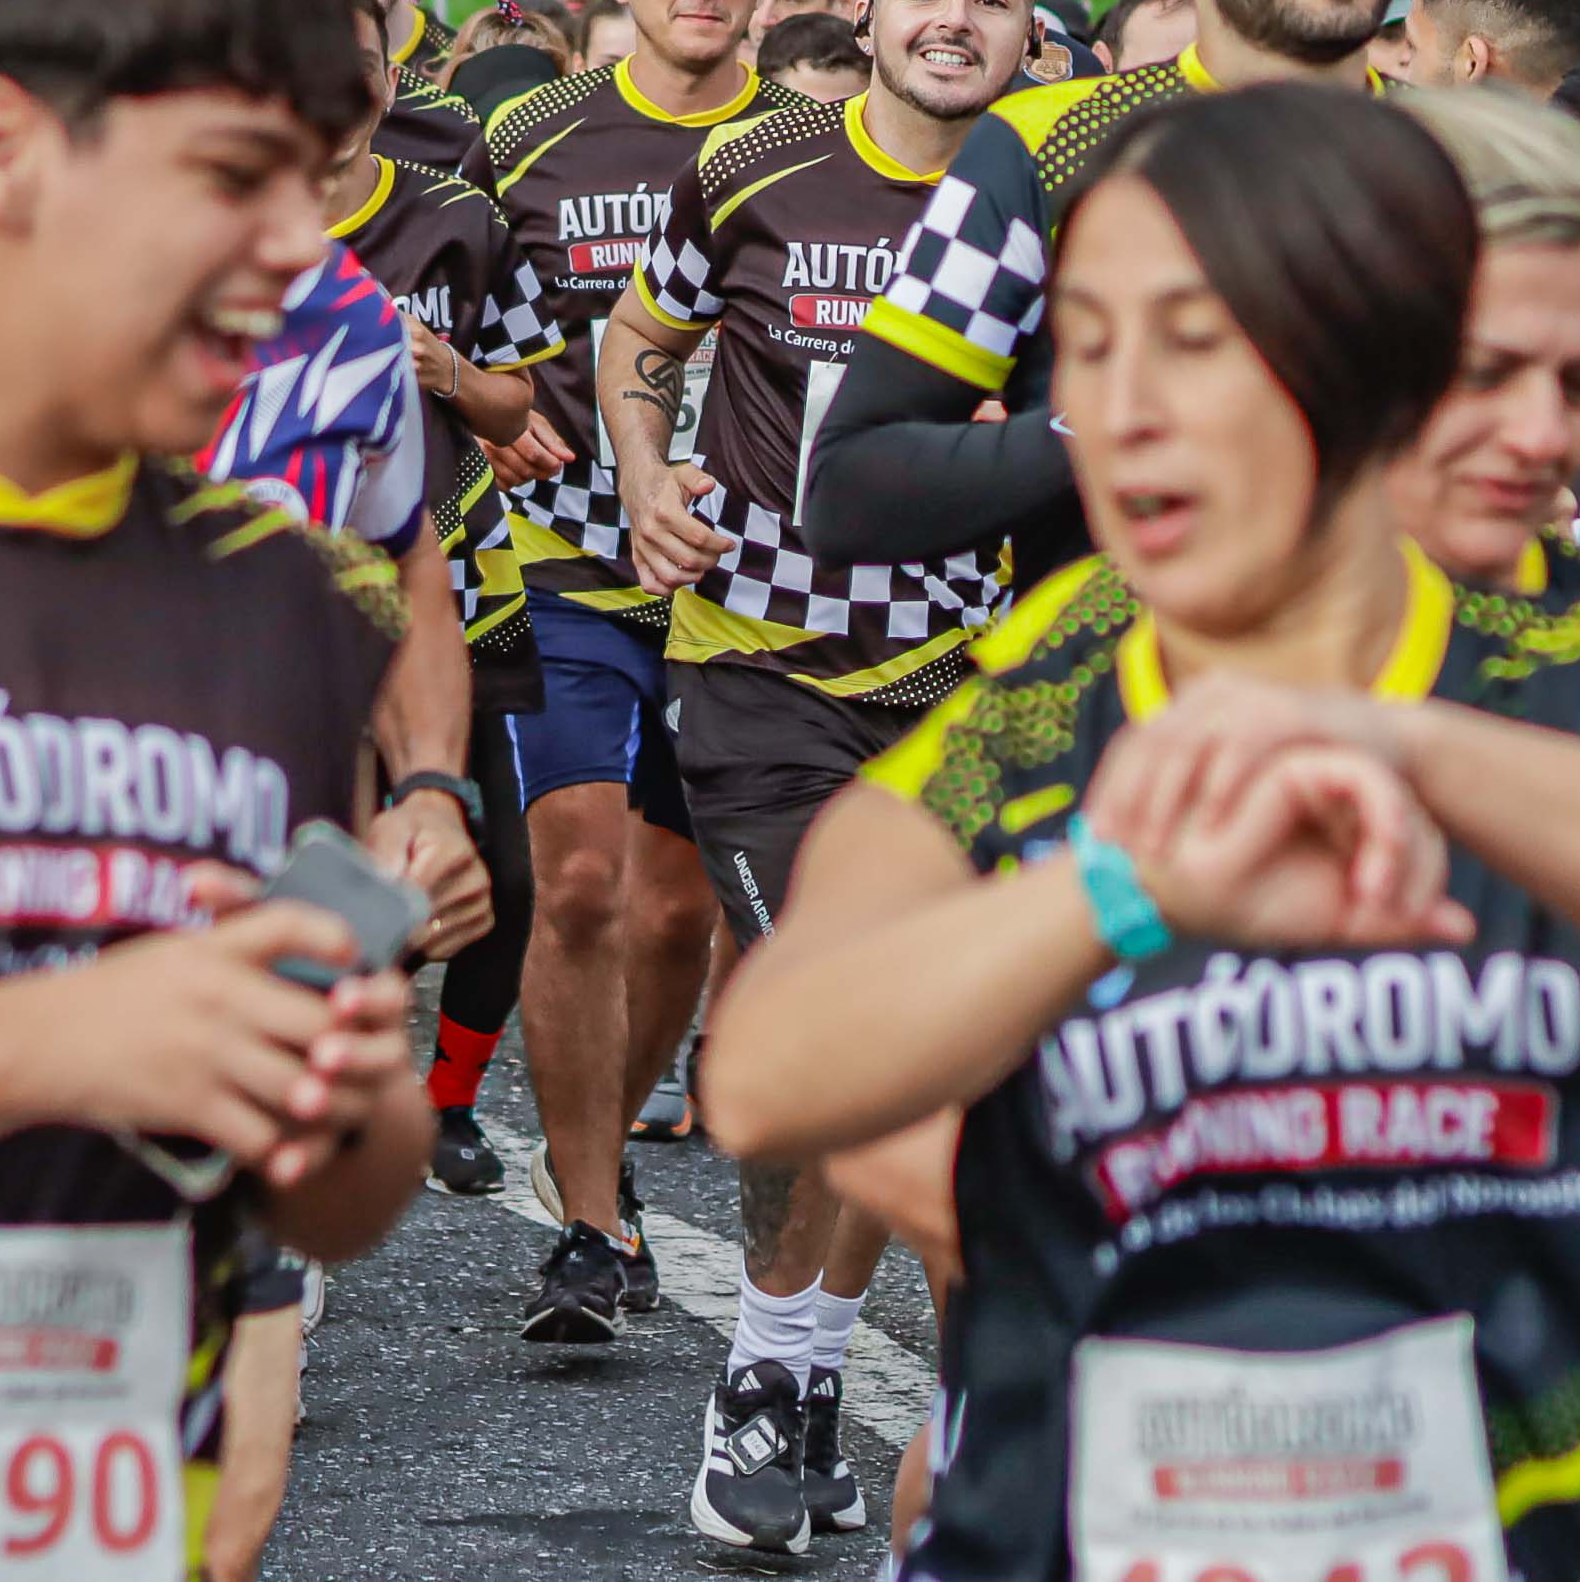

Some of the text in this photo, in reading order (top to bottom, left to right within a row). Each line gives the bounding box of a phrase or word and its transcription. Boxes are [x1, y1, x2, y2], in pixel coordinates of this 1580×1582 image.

[570, 276, 615, 290] Carrera
[781, 237, 903, 294] AUTÓ
[784, 329, 838, 352] Carrera
[733, 850, 759, 900] UNDER
[1338, 1082, 1498, 1162] RACE
